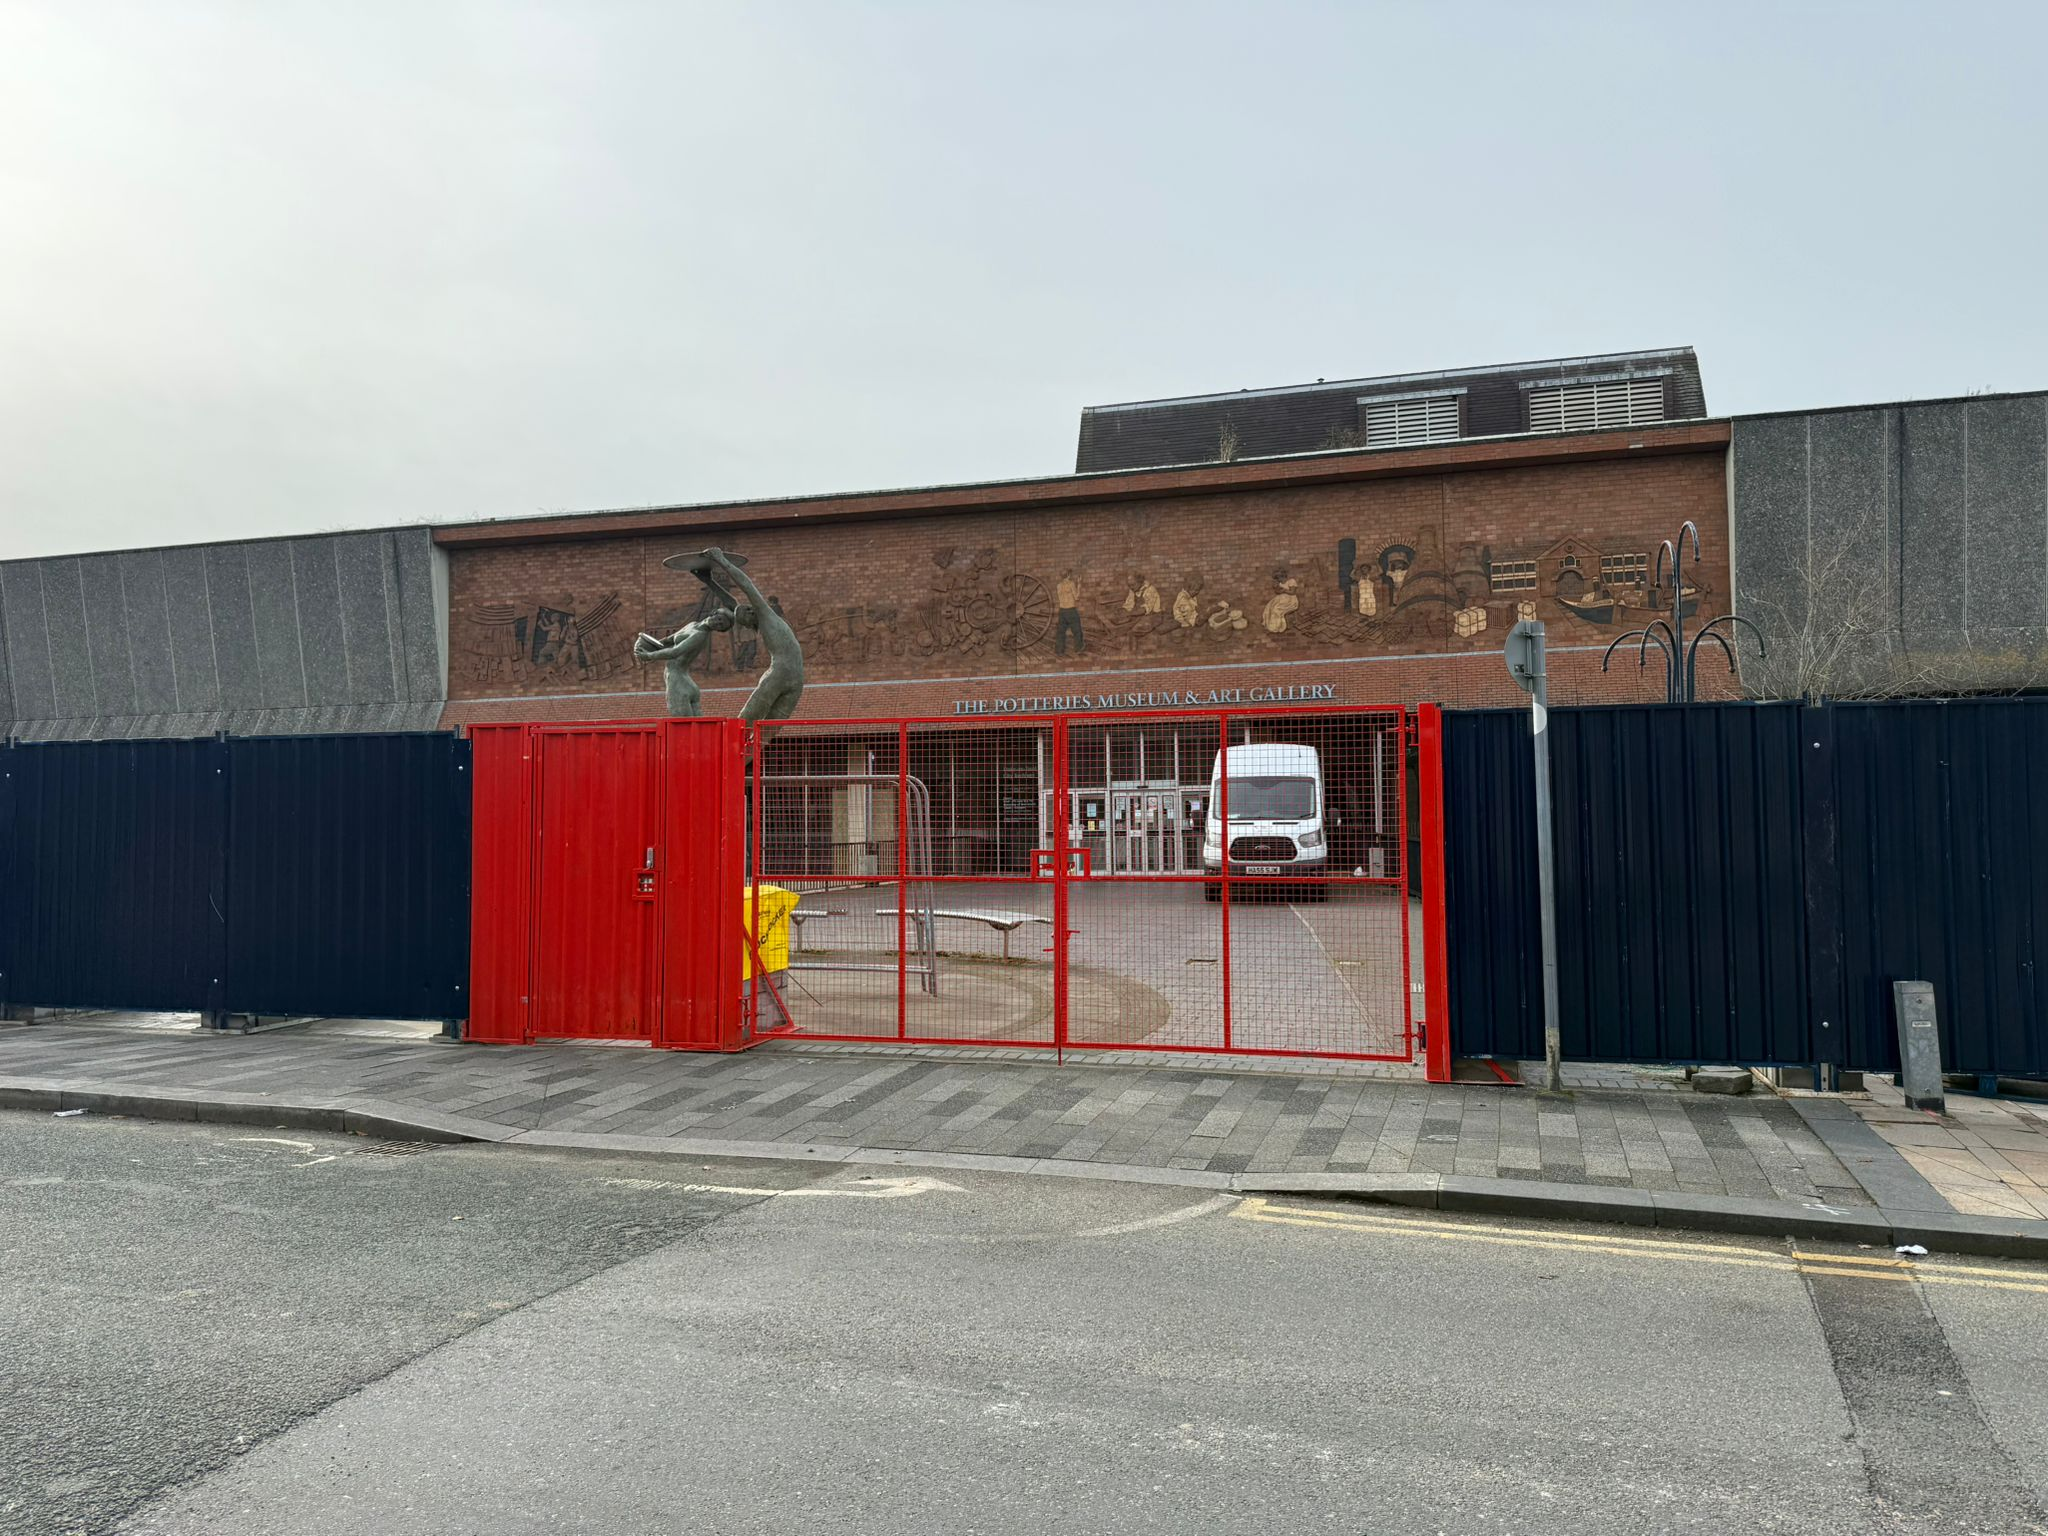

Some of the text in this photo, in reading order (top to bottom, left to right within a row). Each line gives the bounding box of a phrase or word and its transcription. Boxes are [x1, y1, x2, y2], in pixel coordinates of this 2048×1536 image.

[953, 684, 1337, 714] THE POTTERIES MUSEUM & ART GALLERY
